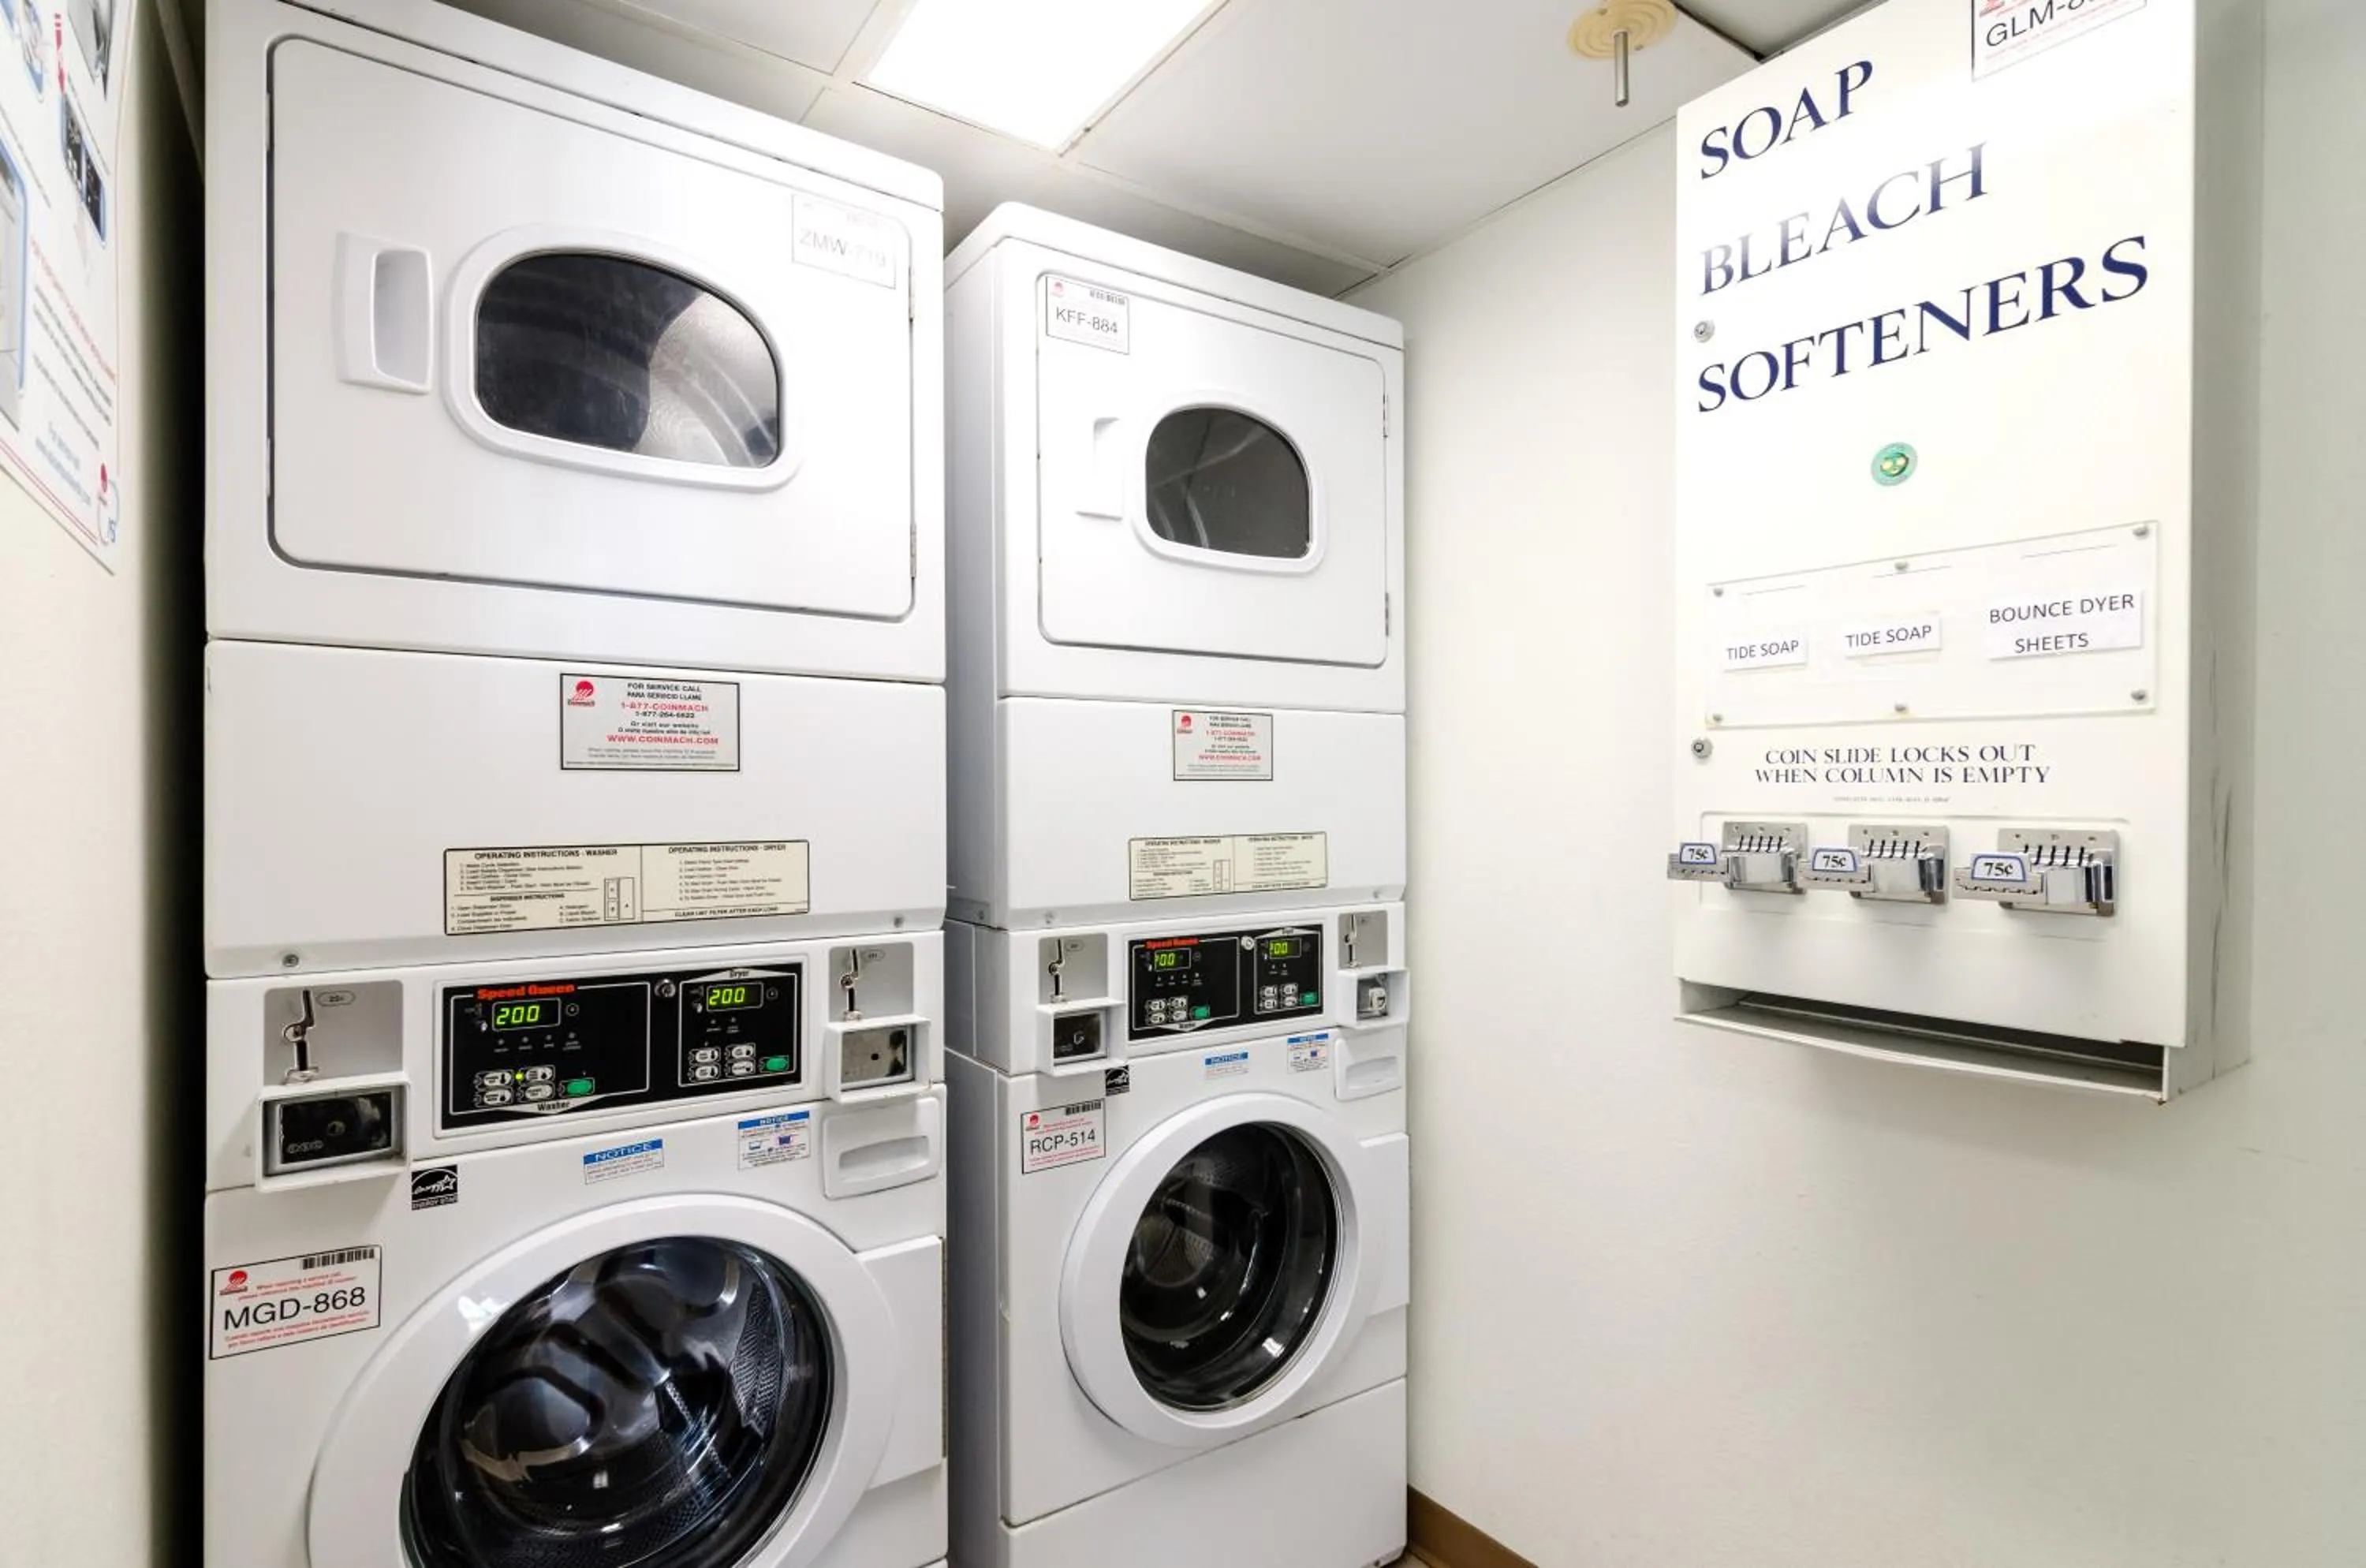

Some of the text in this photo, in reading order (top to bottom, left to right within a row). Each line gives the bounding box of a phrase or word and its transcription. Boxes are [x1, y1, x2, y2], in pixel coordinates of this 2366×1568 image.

[1700, 59, 1874, 180] SOAP
[1699, 141, 1989, 296] BLEACH
[1056, 305, 1118, 334] KFF-884
[1697, 235, 2148, 413] SOFTENERS
[1989, 593, 2135, 624] BOUNCE DYER
[1845, 624, 1932, 648] TIDE SOAP
[2014, 632, 2090, 654] SHEETS
[1726, 639, 1800, 660] TIDE SOAP
[682, 684, 701, 693] CALL
[621, 702, 709, 712] 1-877-COINMACH
[606, 734, 719, 745] WWW.COINMACH.COM
[1765, 743, 2036, 764] COIN SLIDE LOCKS OUT
[1755, 766, 2051, 784] WHEN COLUMN IS EMPTY
[475, 851, 521, 860] OPERATING
[523, 849, 580, 858] INSTRUCTIONS
[1687, 847, 1709, 861] 75¢
[1822, 853, 1848, 871] 75¢
[1983, 862, 2013, 877] 75¢
[477, 984, 575, 1000] Speed Queen
[709, 987, 745, 1006] 200
[495, 1004, 540, 1025] 200
[536, 1101, 570, 1111] Washer
[1029, 1129, 1095, 1155] RCP-514
[595, 1143, 651, 1162] NOTICE
[223, 1286, 365, 1331] MGD-868
